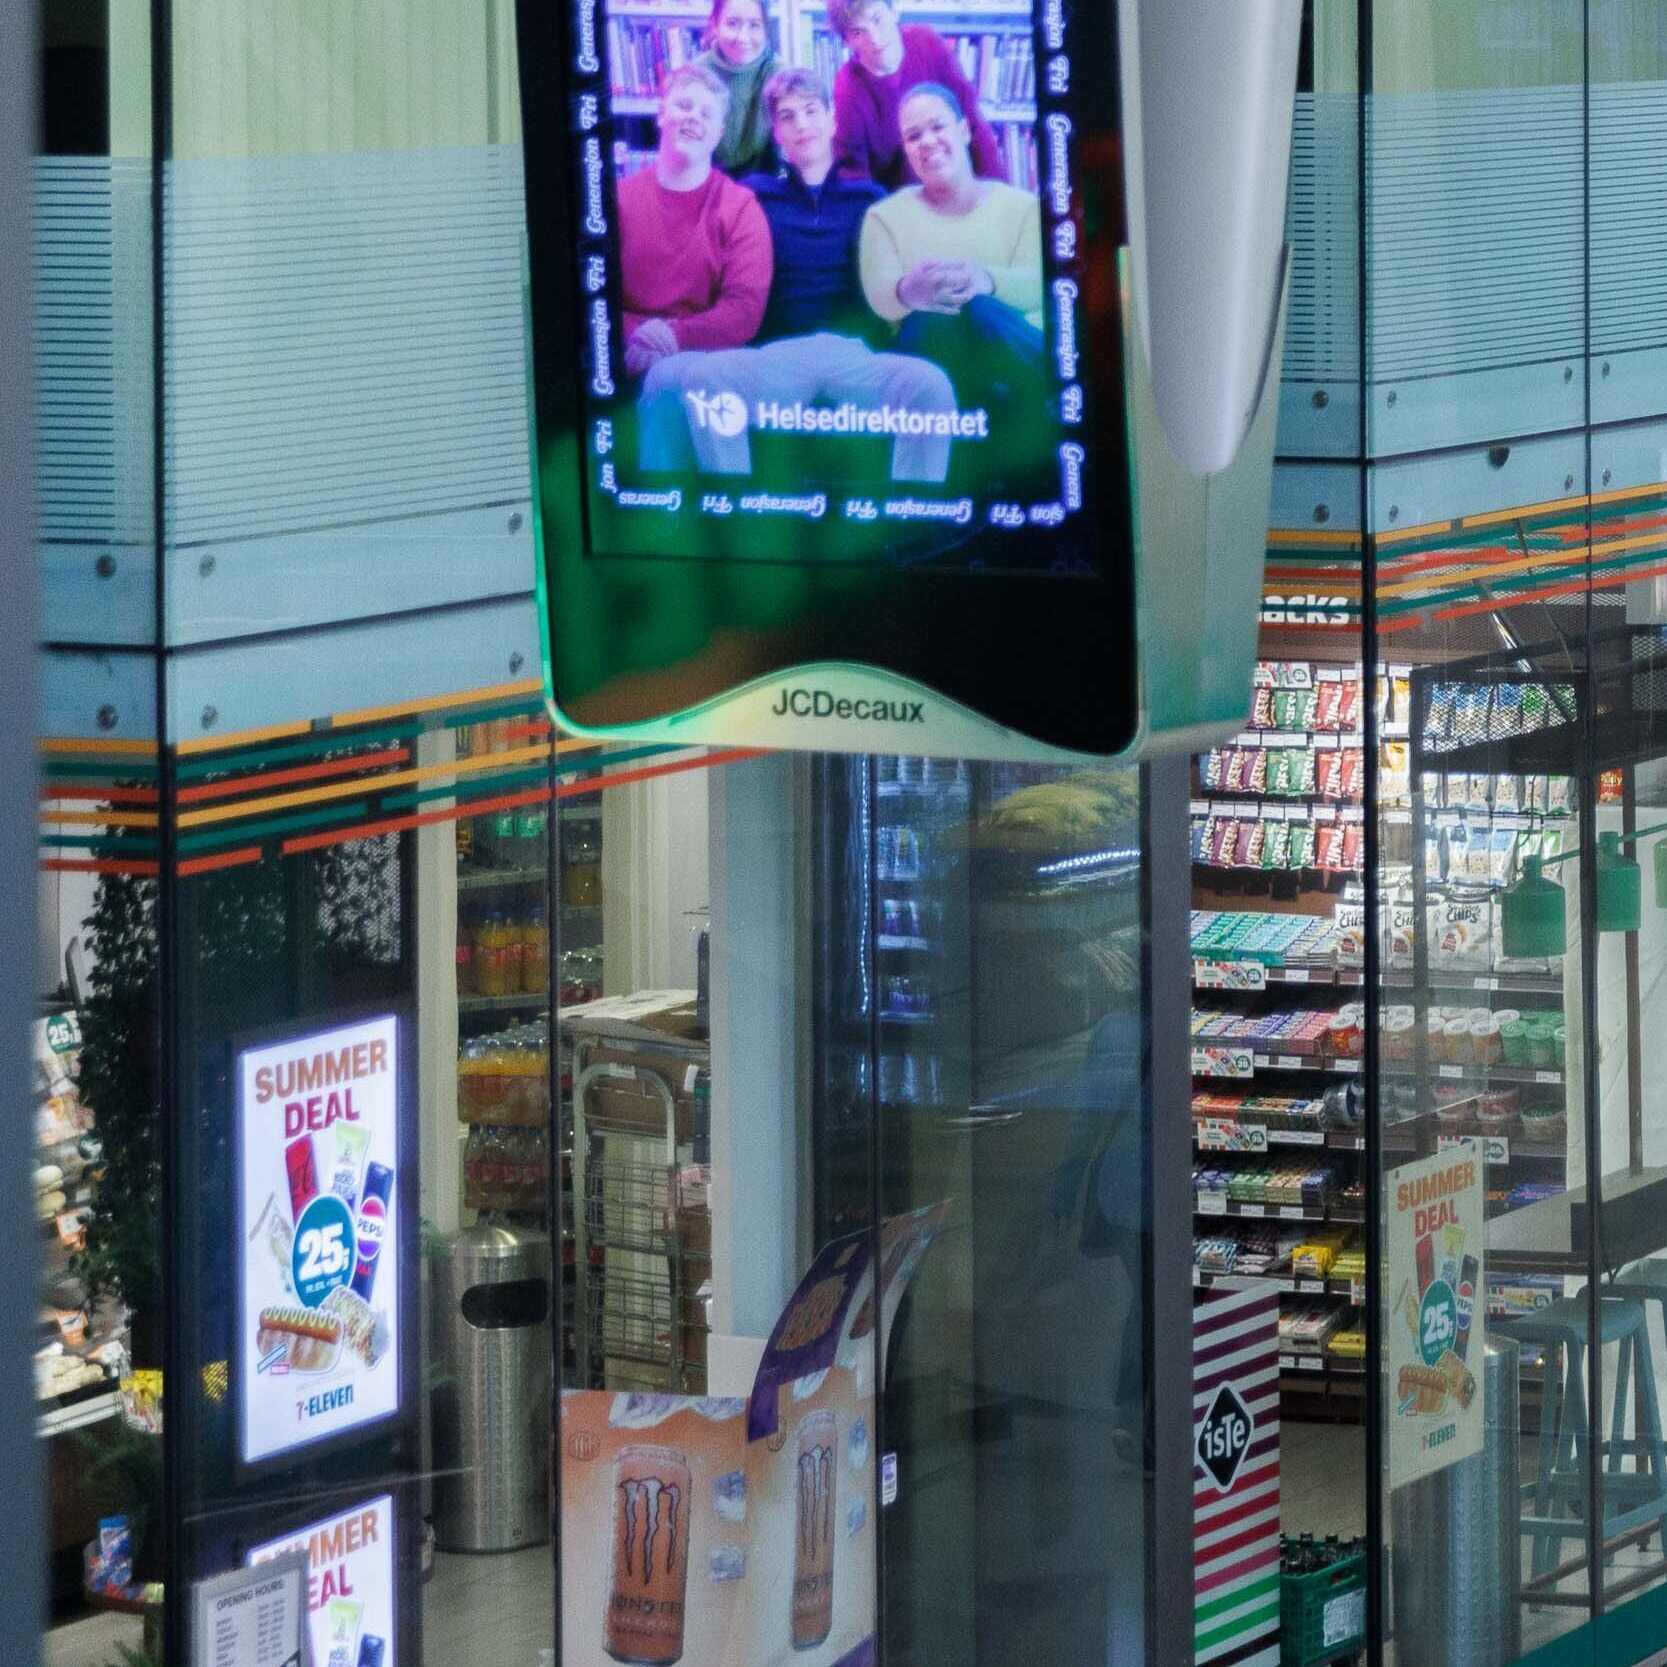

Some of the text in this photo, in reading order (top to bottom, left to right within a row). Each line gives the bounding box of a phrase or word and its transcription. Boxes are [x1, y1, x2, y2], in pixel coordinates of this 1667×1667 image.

[1048, 55, 1069, 93] Fri
[579, 94, 607, 235] Generasjon Fri
[1046, 113, 1076, 258] Generasjon Fri
[586, 255, 615, 396] Generasjon Fri
[1053, 278, 1082, 423] Generasjon Fri
[596, 420, 613, 455] Fri
[758, 403, 988, 437] Helsedirektoratet
[1059, 442, 1085, 510] Genera
[702, 493, 826, 518] Generasjon Fri
[846, 498, 972, 523] Generasjon Fri
[991, 504, 1026, 525] Fri
[1259, 594, 1349, 623] acks
[772, 689, 924, 723] JCDecaux
[255, 1038, 387, 1104] SUMMER
[285, 1087, 360, 1139] DEAL
[1397, 1160, 1475, 1213] SUMMER
[1415, 1199, 1460, 1238] DEAL
[297, 1384, 354, 1420] 7-ELEVEN
[256, 1509, 379, 1567] MMER
[308, 1563, 353, 1613] EAL
